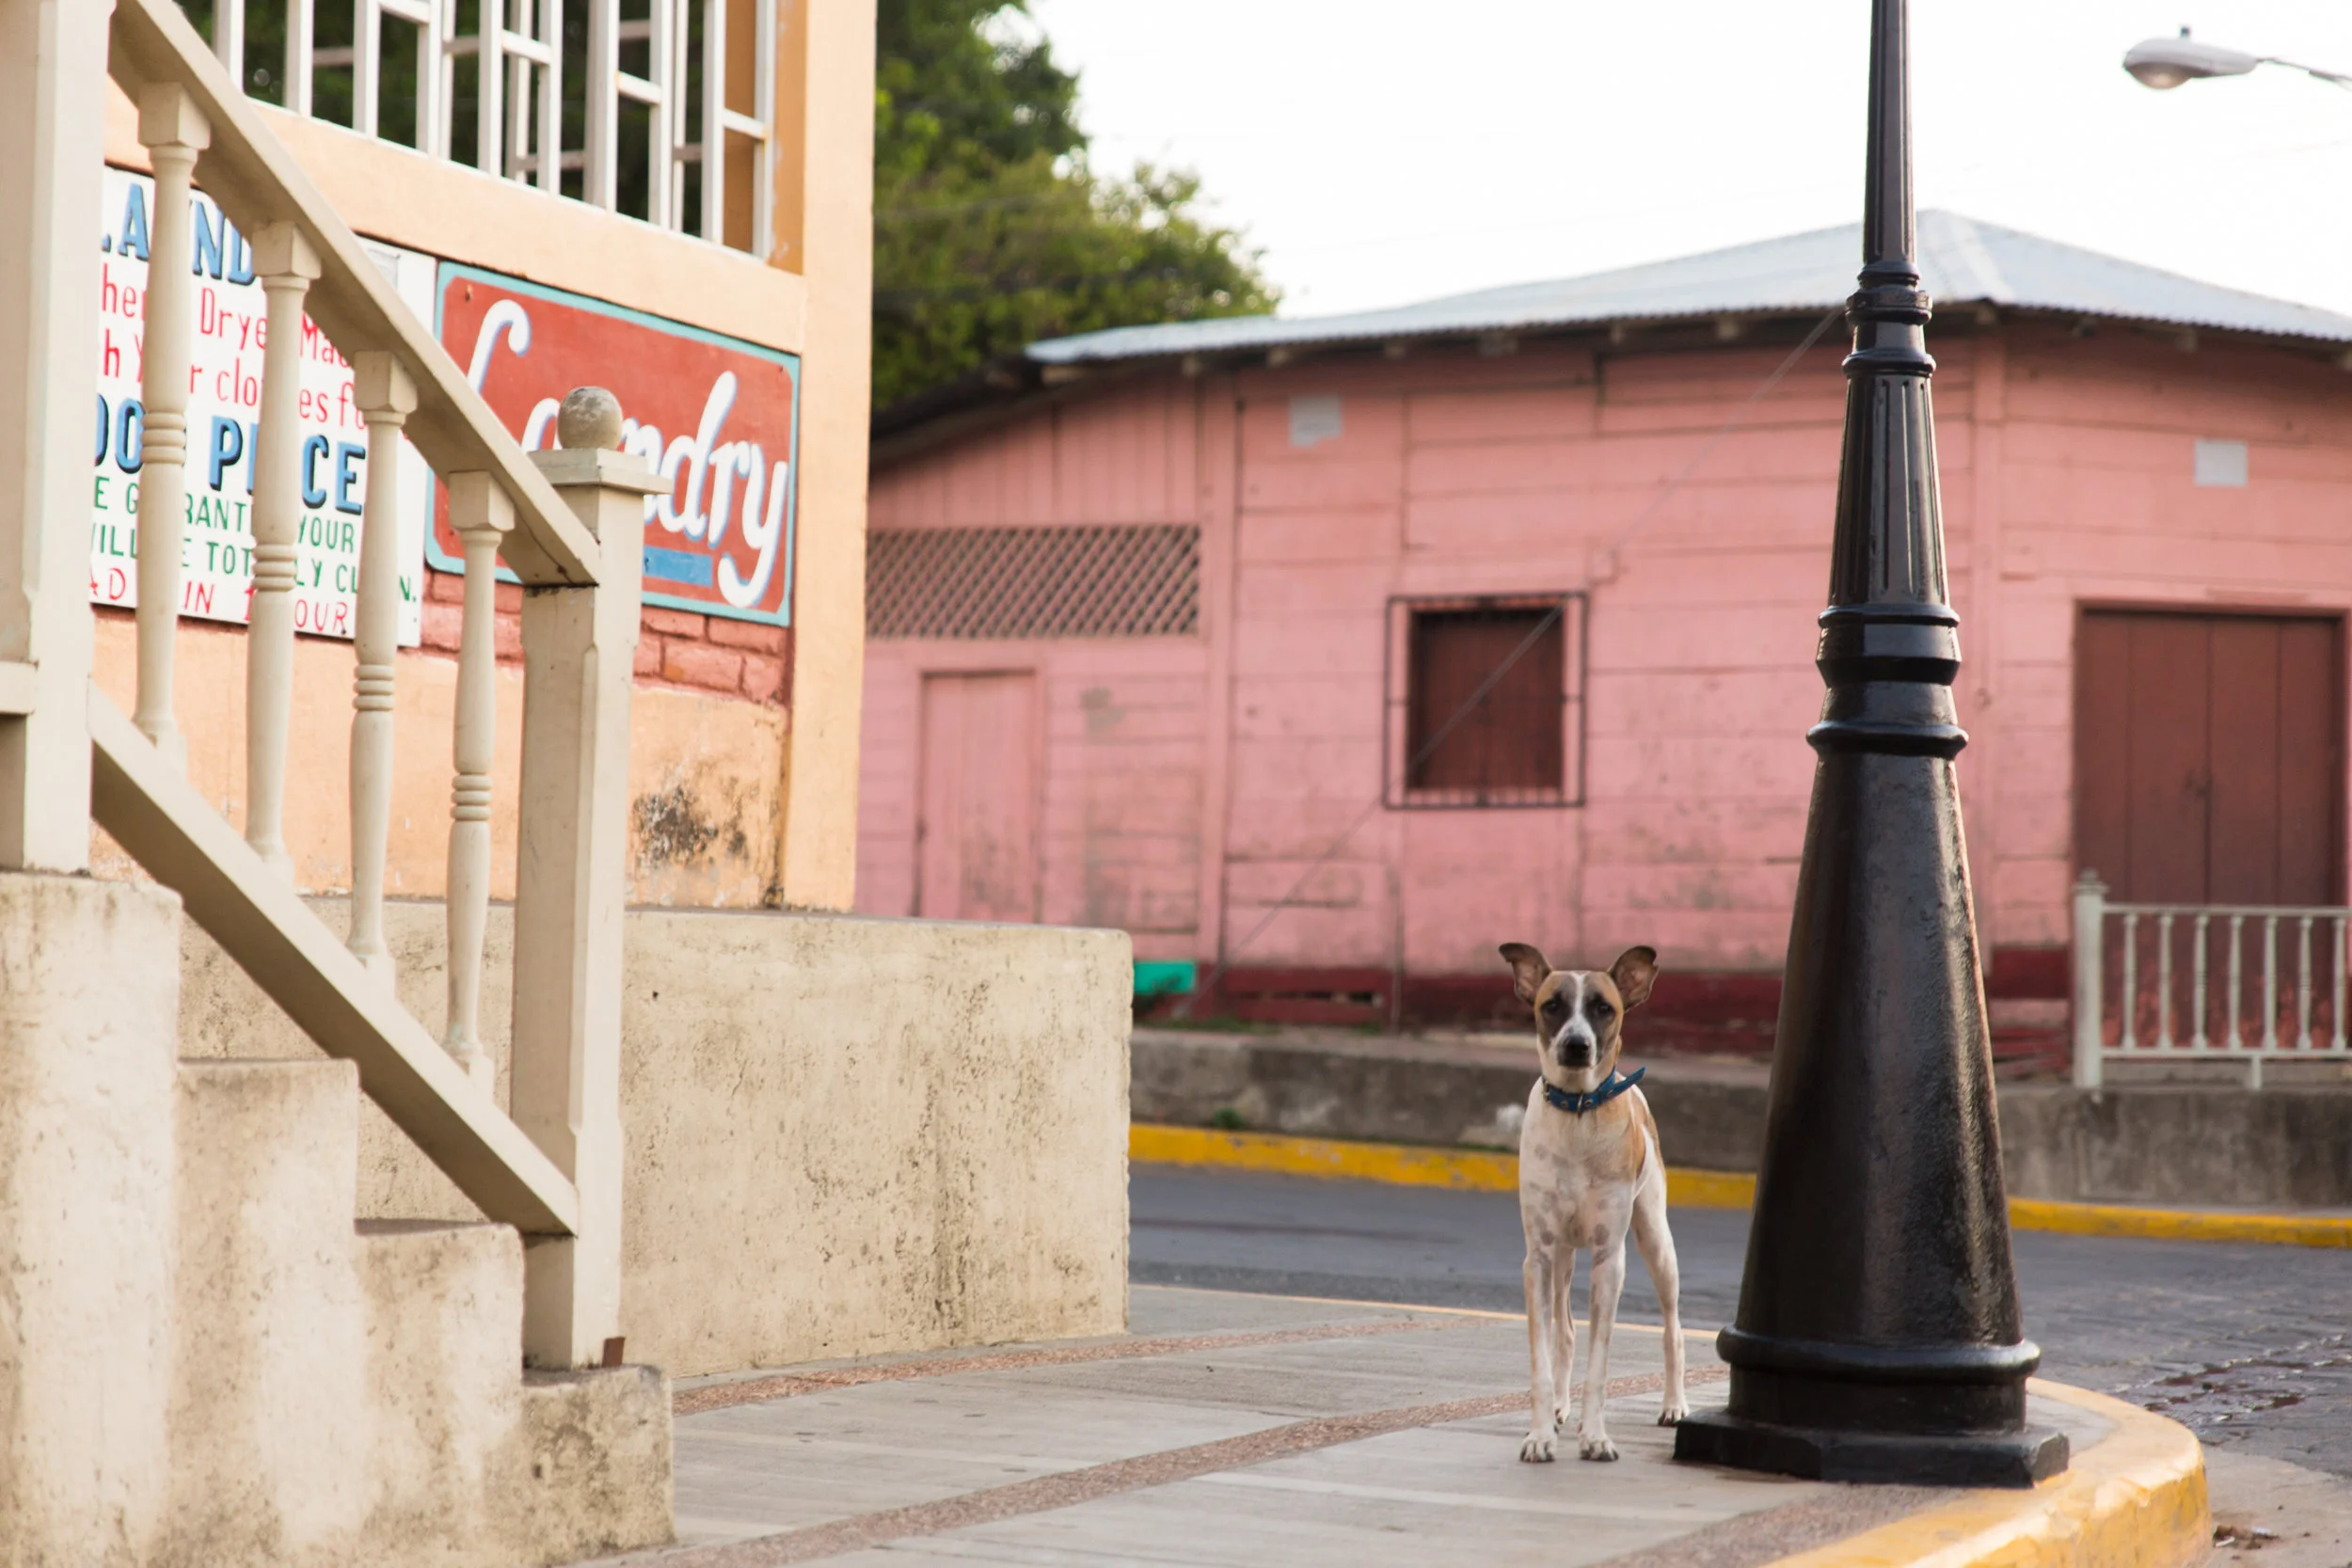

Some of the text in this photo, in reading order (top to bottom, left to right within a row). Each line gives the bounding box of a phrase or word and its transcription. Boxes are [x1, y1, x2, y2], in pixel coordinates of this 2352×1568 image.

[200, 287, 266, 351] Drye
[216, 357, 328, 423] cloes
[209, 415, 366, 516] PCE
[294, 598, 348, 632] OUR
